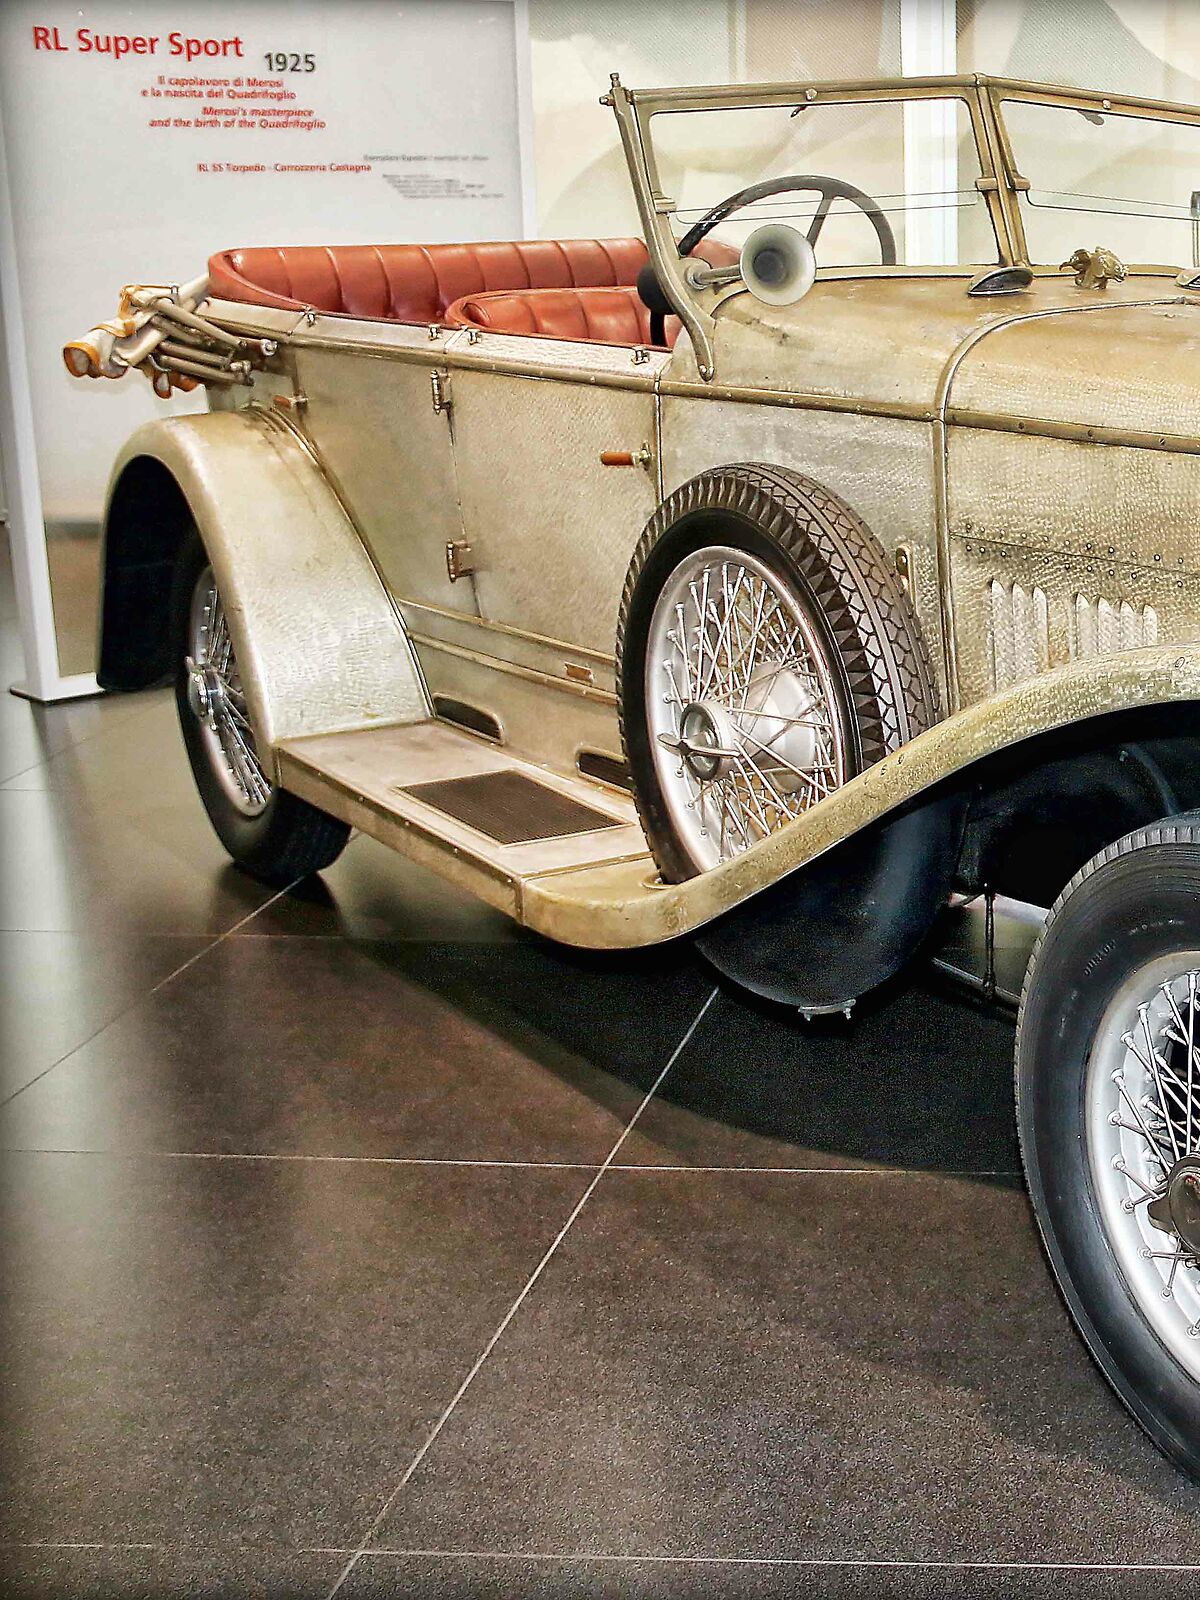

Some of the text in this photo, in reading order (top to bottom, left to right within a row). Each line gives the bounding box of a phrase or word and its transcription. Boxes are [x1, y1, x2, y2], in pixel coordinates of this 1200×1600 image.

[33, 26, 244, 61] RL Super Sport
[264, 52, 316, 73] 1925
[157, 75, 284, 88] Il capolavoro di Merosi
[141, 86, 297, 101] e la nascita del Quadrifoglio
[202, 106, 314, 119] Merosi's masterpiece
[149, 117, 326, 131] and the birth of the Quadrifoglio
[330, 163, 372, 174] Castagna
